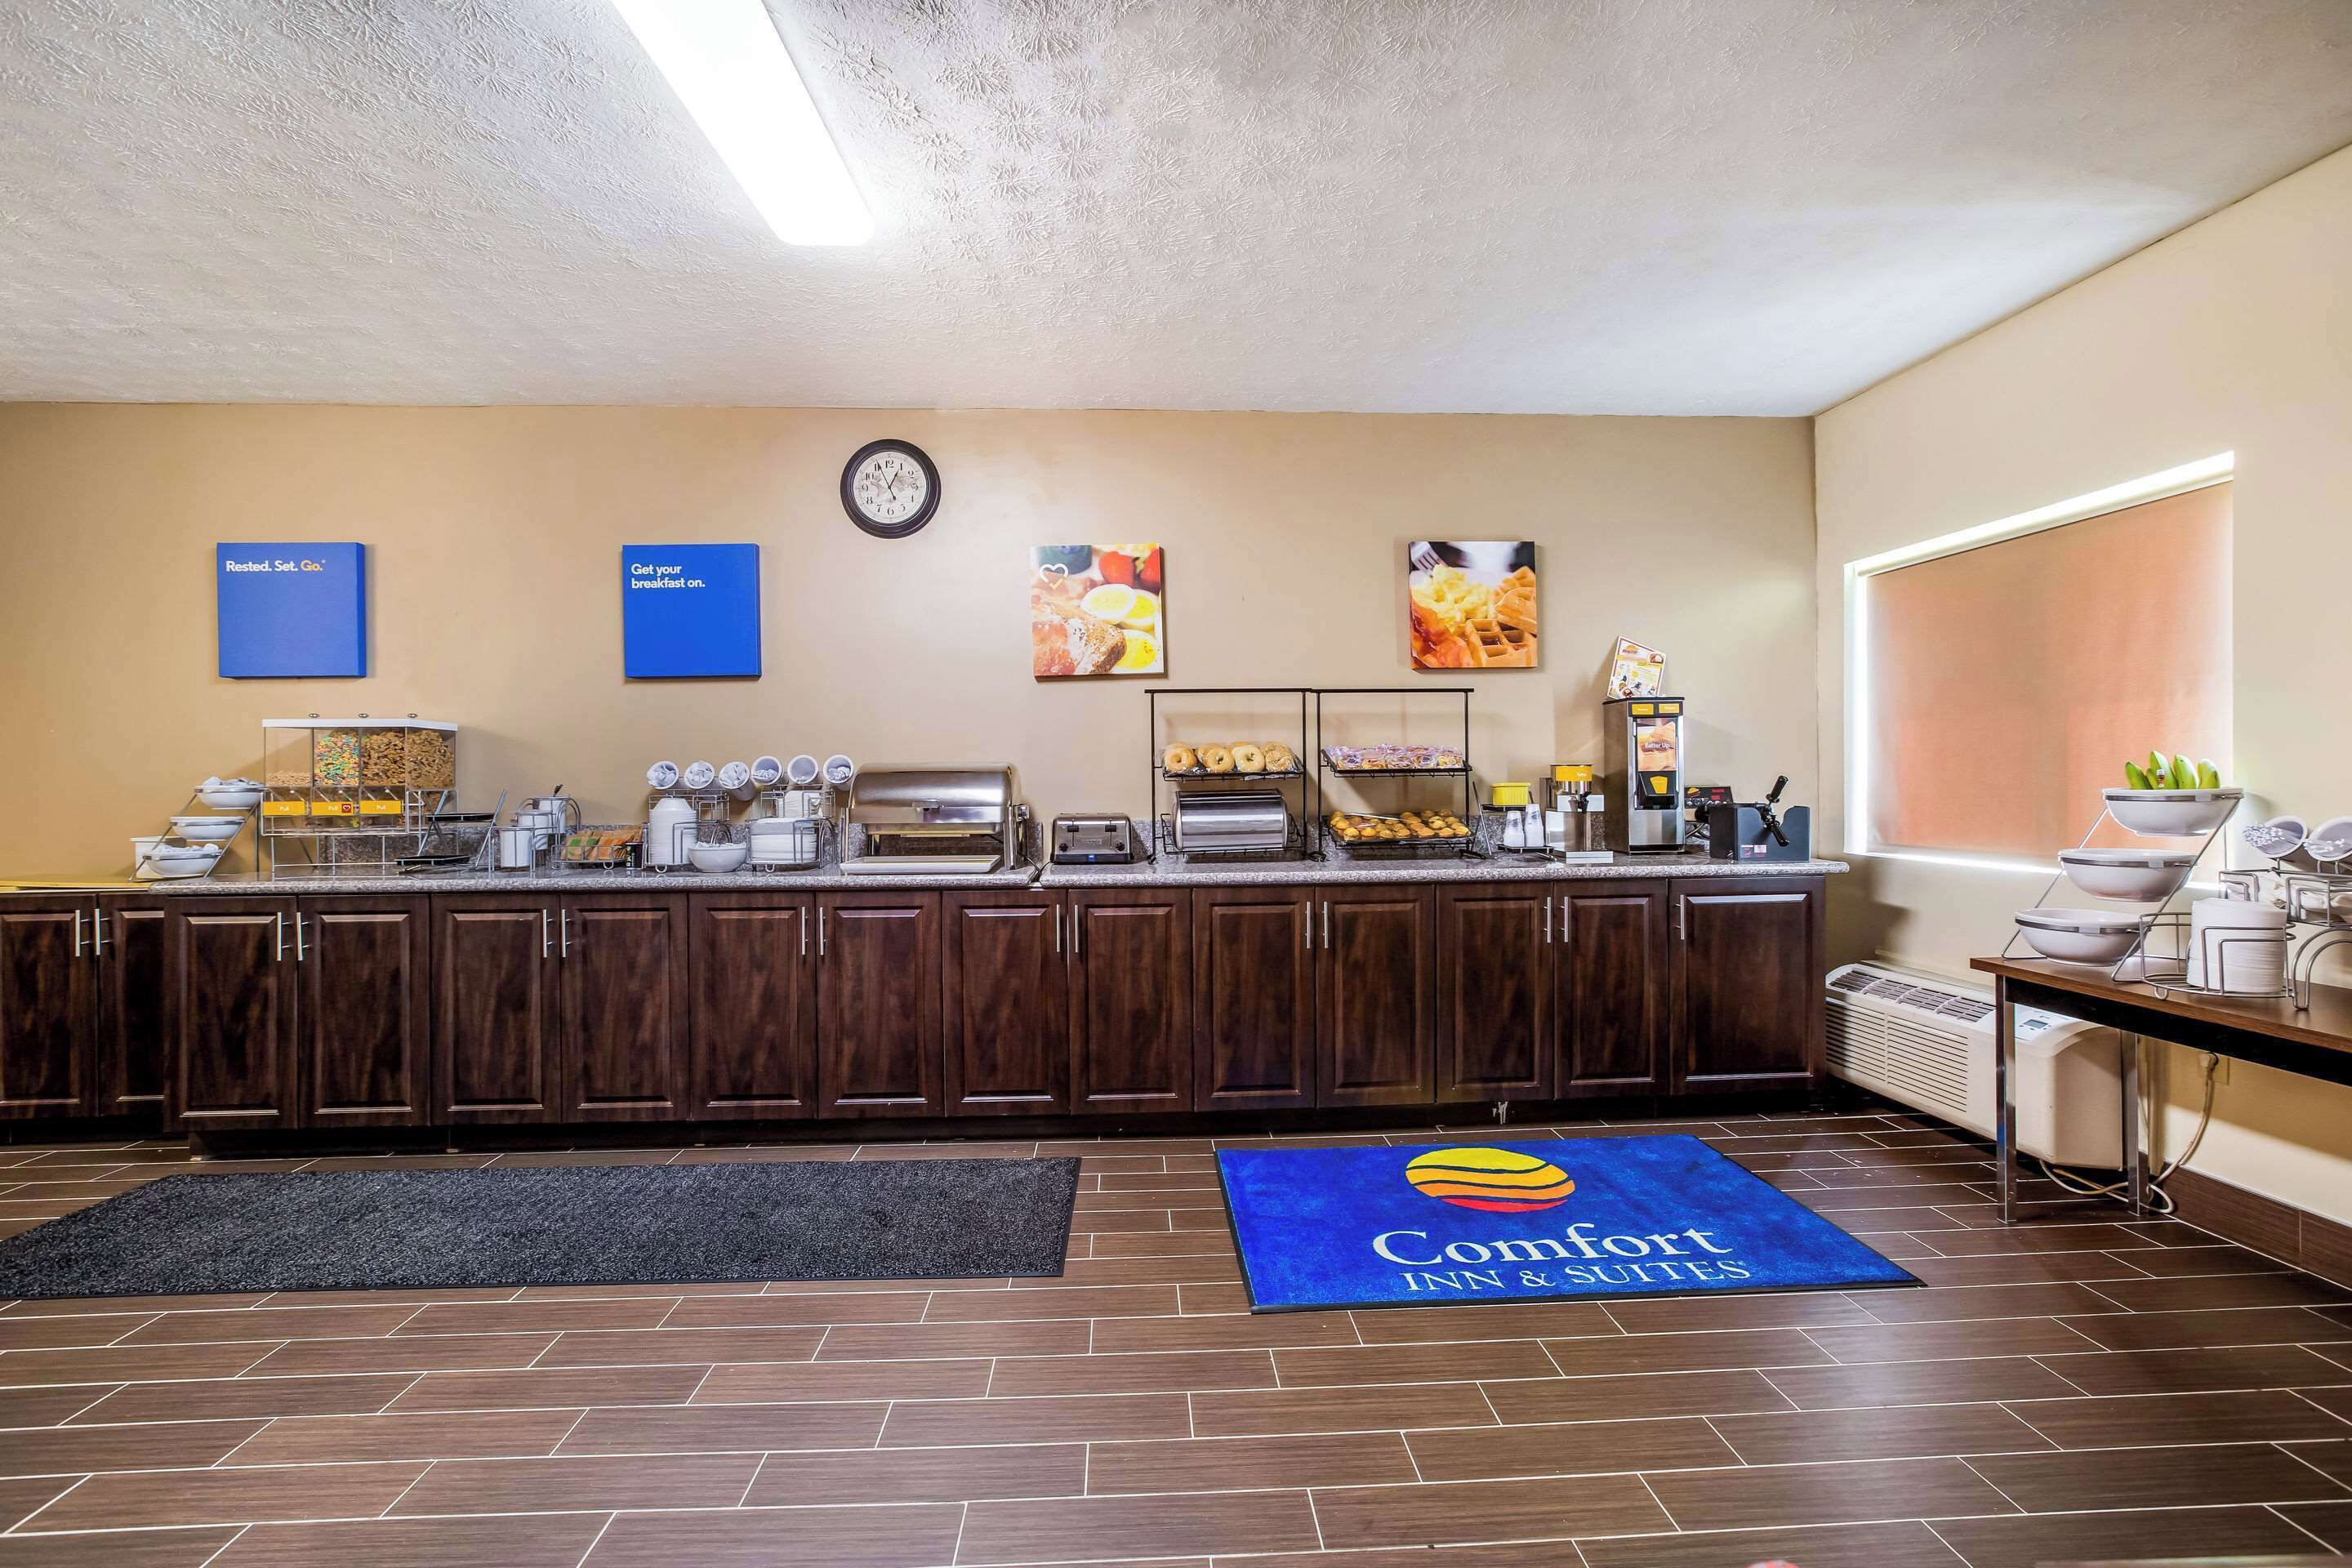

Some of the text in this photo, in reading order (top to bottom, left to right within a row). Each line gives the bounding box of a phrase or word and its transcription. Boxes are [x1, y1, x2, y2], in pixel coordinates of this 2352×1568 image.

[885, 460, 894, 469] 12
[866, 472, 874, 481] 10
[907, 470, 915, 479] 2
[862, 483, 869, 492] 9
[866, 497, 873, 505] 8
[877, 504, 883, 513] 7
[225, 559, 273, 572] Rested.
[274, 559, 299, 572] Set.
[631, 563, 683, 577] Get your
[631, 577, 706, 588] breakfast on.
[1372, 1223, 1733, 1265] Comfort
[1399, 1260, 1751, 1291] INN & SUITES
